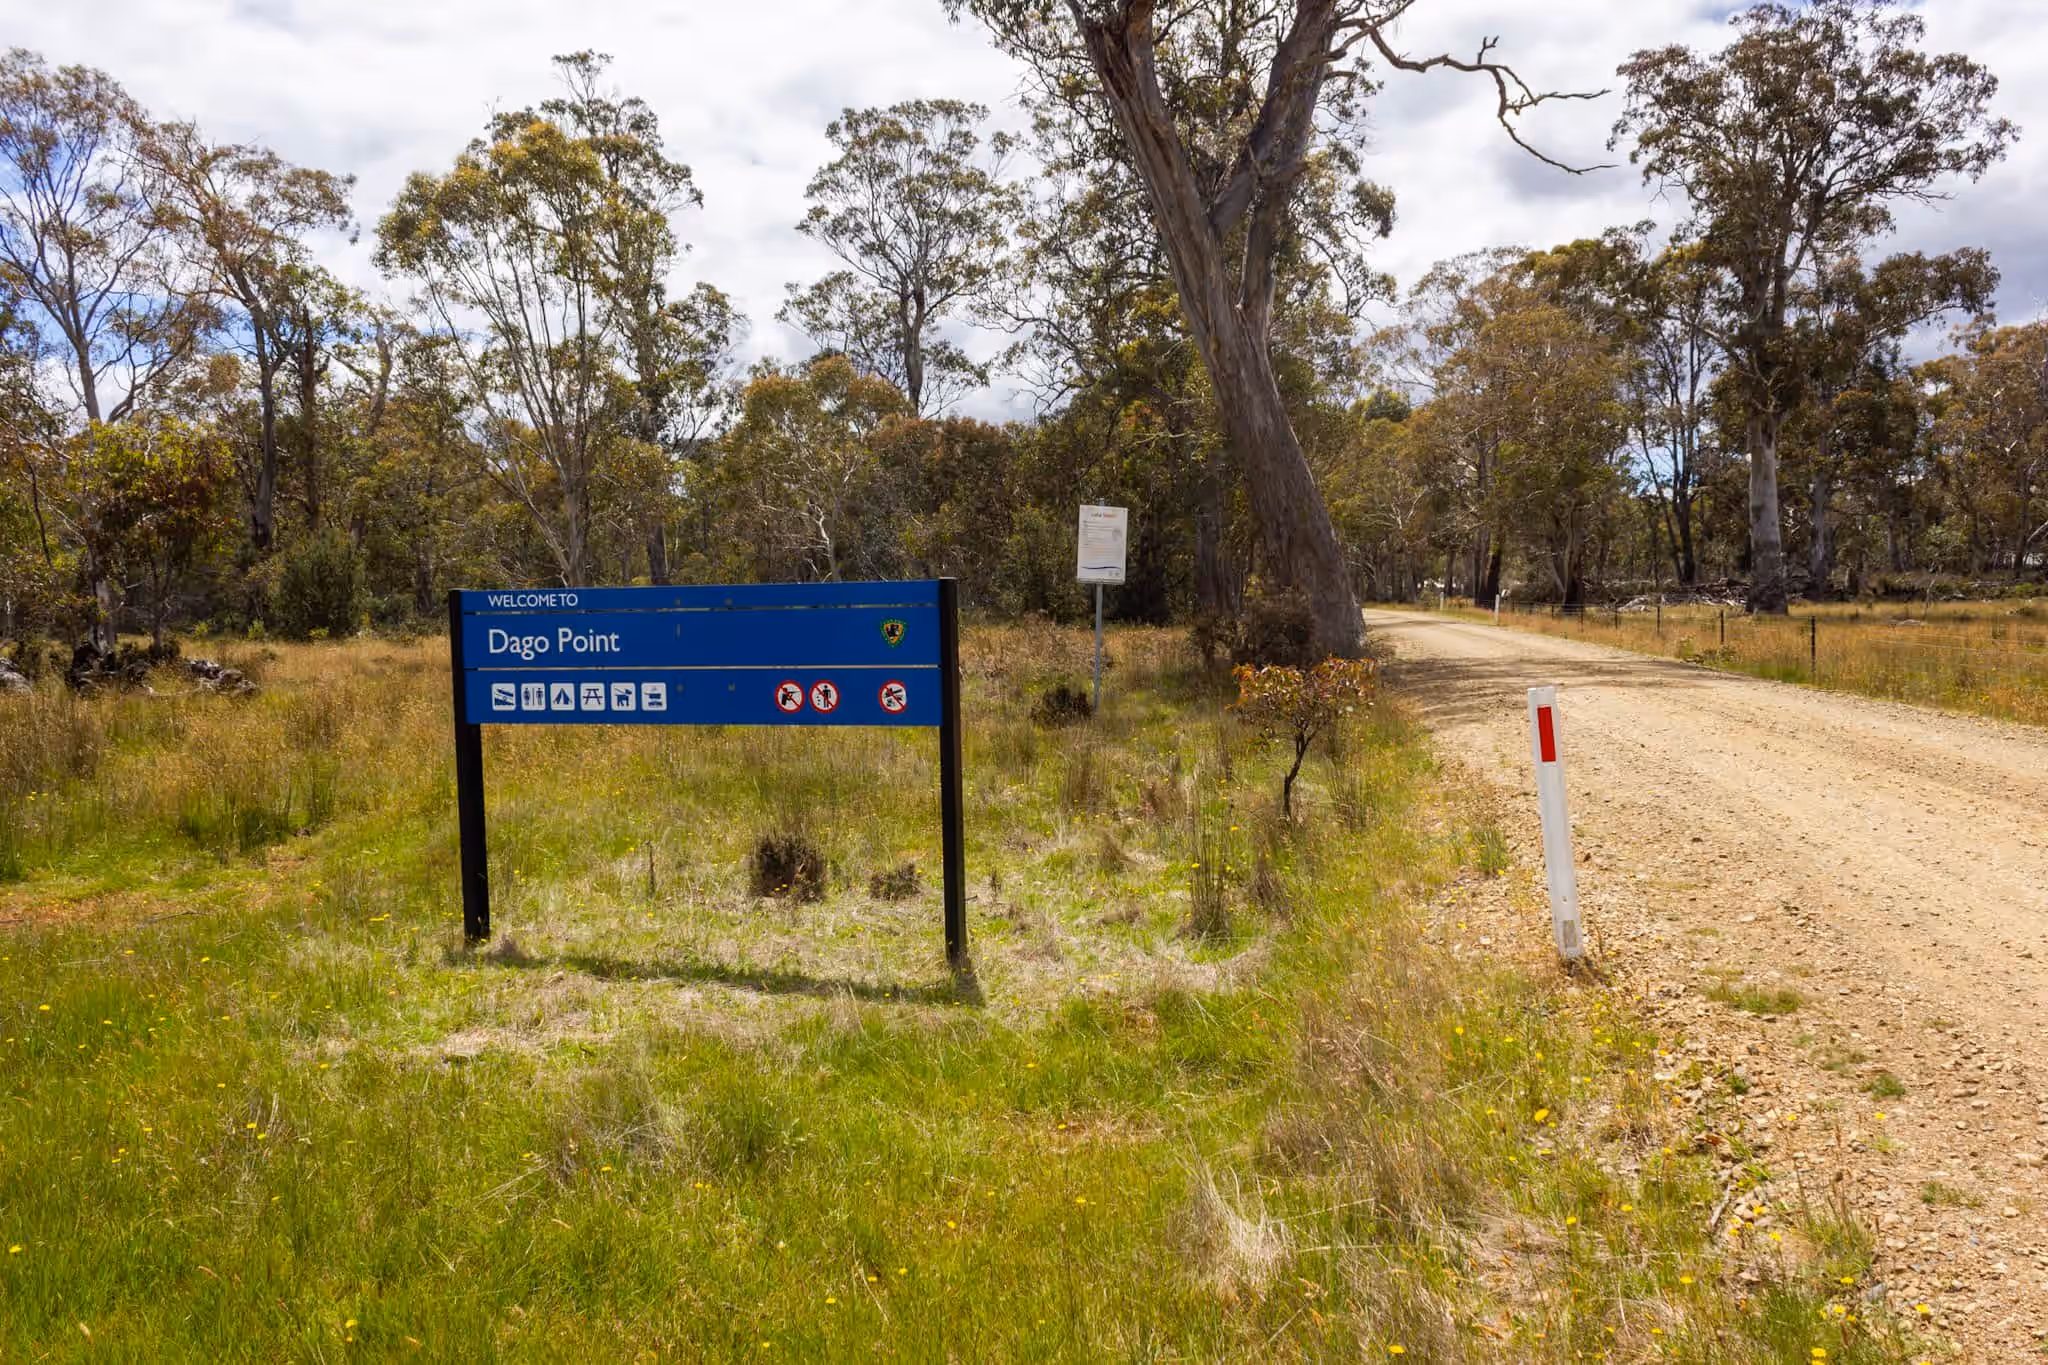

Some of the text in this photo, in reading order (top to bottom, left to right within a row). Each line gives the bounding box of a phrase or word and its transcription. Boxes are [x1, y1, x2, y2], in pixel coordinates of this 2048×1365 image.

[488, 593, 578, 607] WELCOME TO
[488, 627, 620, 660] Dago Point
